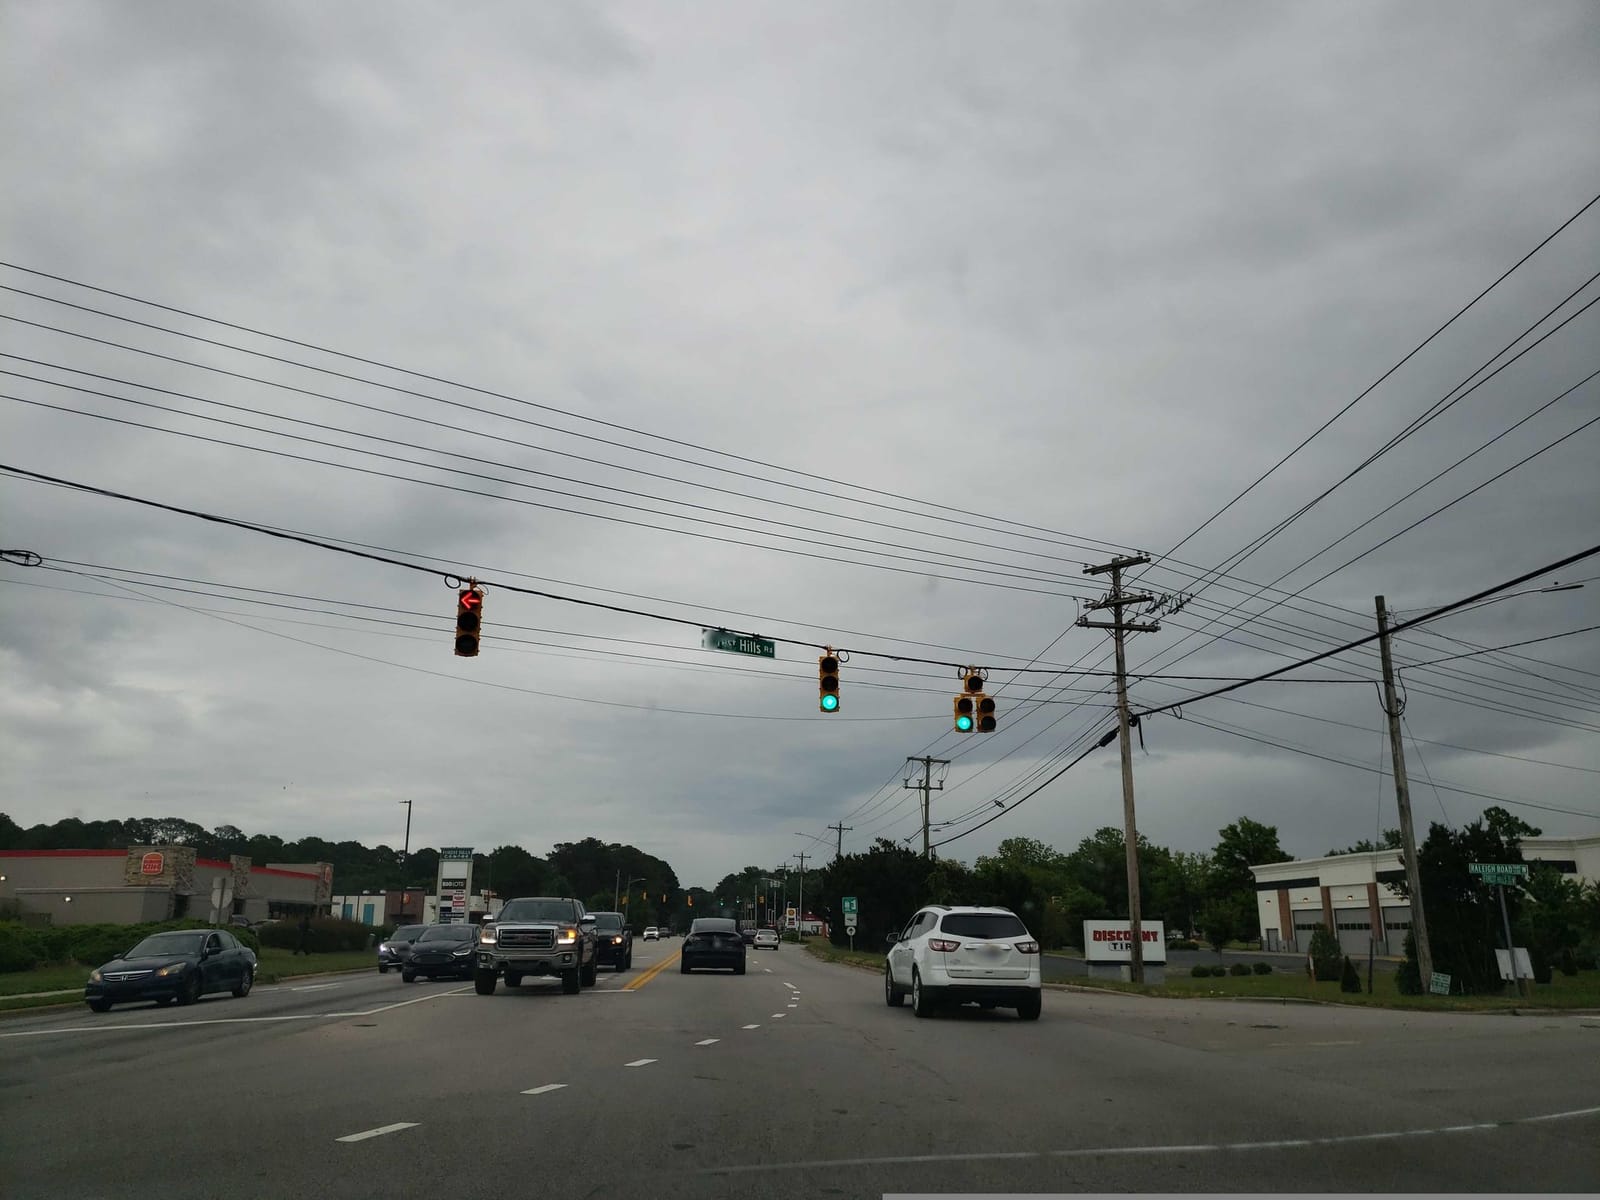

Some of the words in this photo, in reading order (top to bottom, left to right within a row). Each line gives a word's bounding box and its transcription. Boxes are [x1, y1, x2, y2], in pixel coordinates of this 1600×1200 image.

[739, 639, 761, 654] Hills
[1470, 864, 1495, 873] RALEIGH
[1497, 864, 1513, 873] ROAD
[1093, 930, 1159, 942] DISCONT
